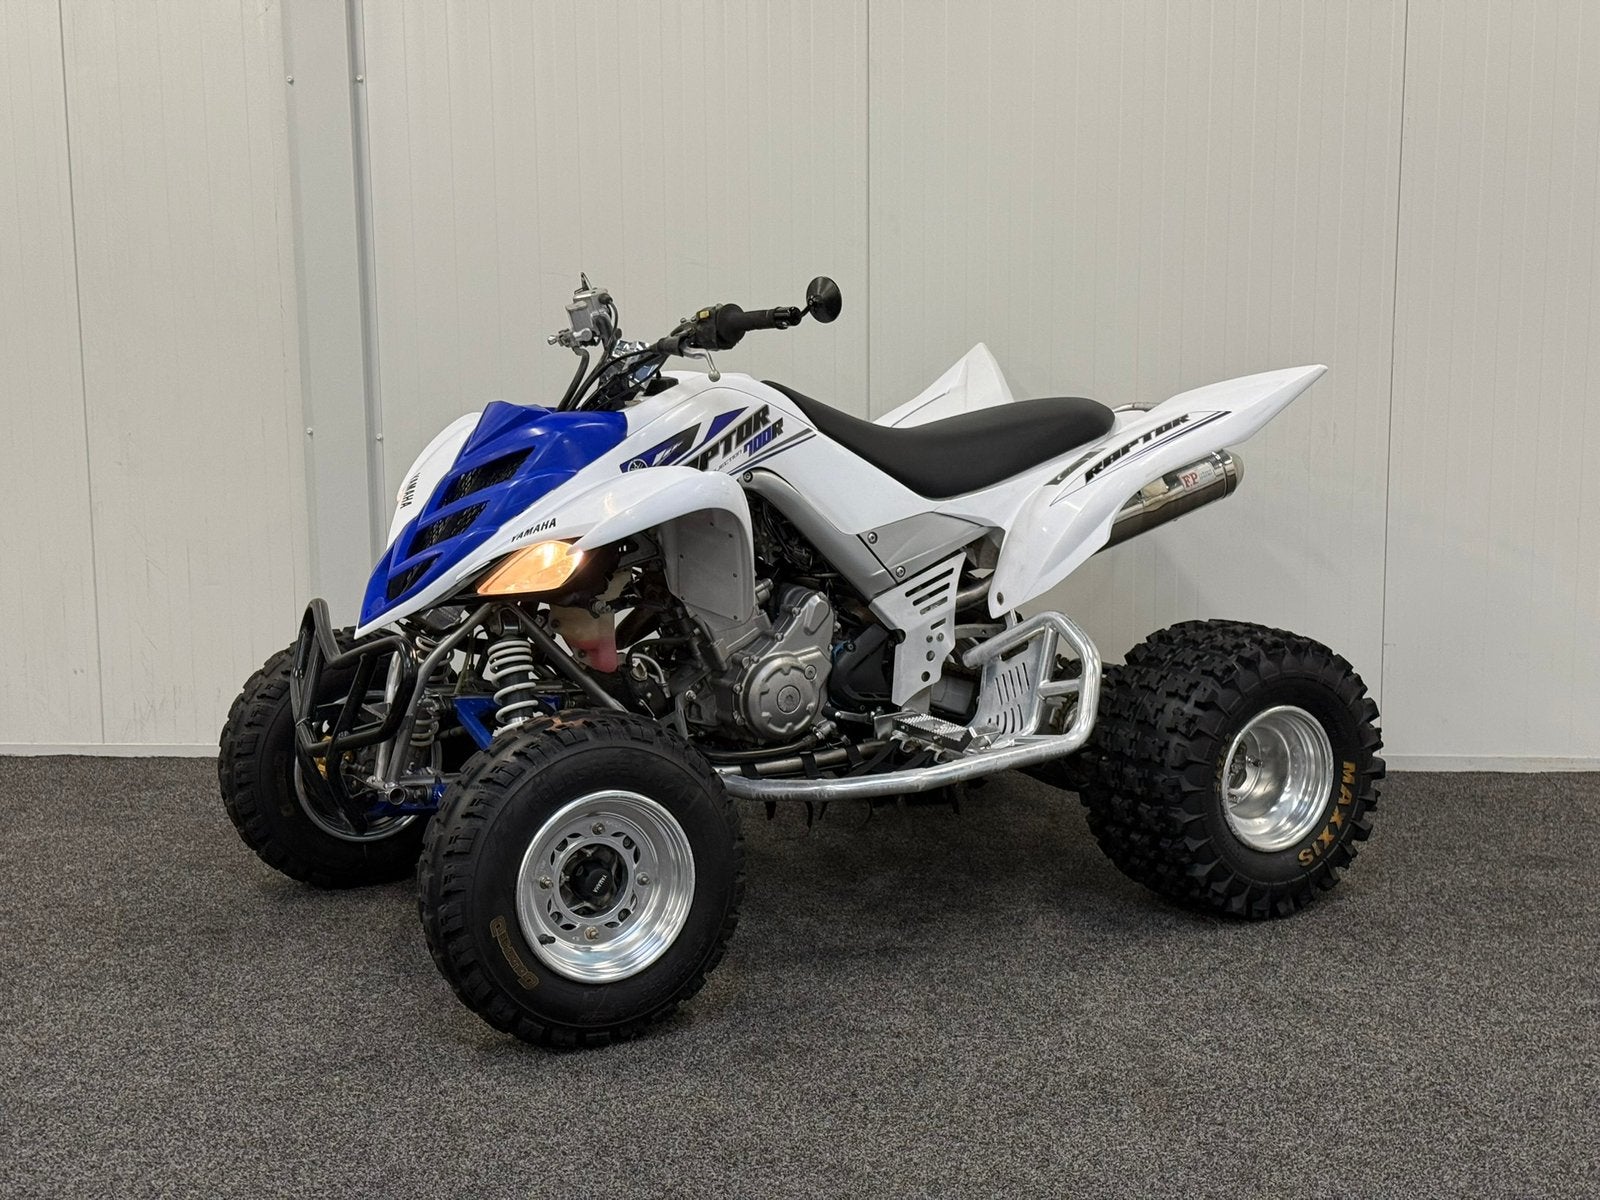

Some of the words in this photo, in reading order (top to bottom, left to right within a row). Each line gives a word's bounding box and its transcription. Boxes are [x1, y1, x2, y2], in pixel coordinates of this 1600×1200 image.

[743, 417, 784, 457] 700R
[1085, 414, 1190, 484] RAPTOR
[400, 472, 420, 509] YAMAHA
[511, 518, 557, 543] YAMAHA
[1298, 761, 1356, 866] MAXXIS
